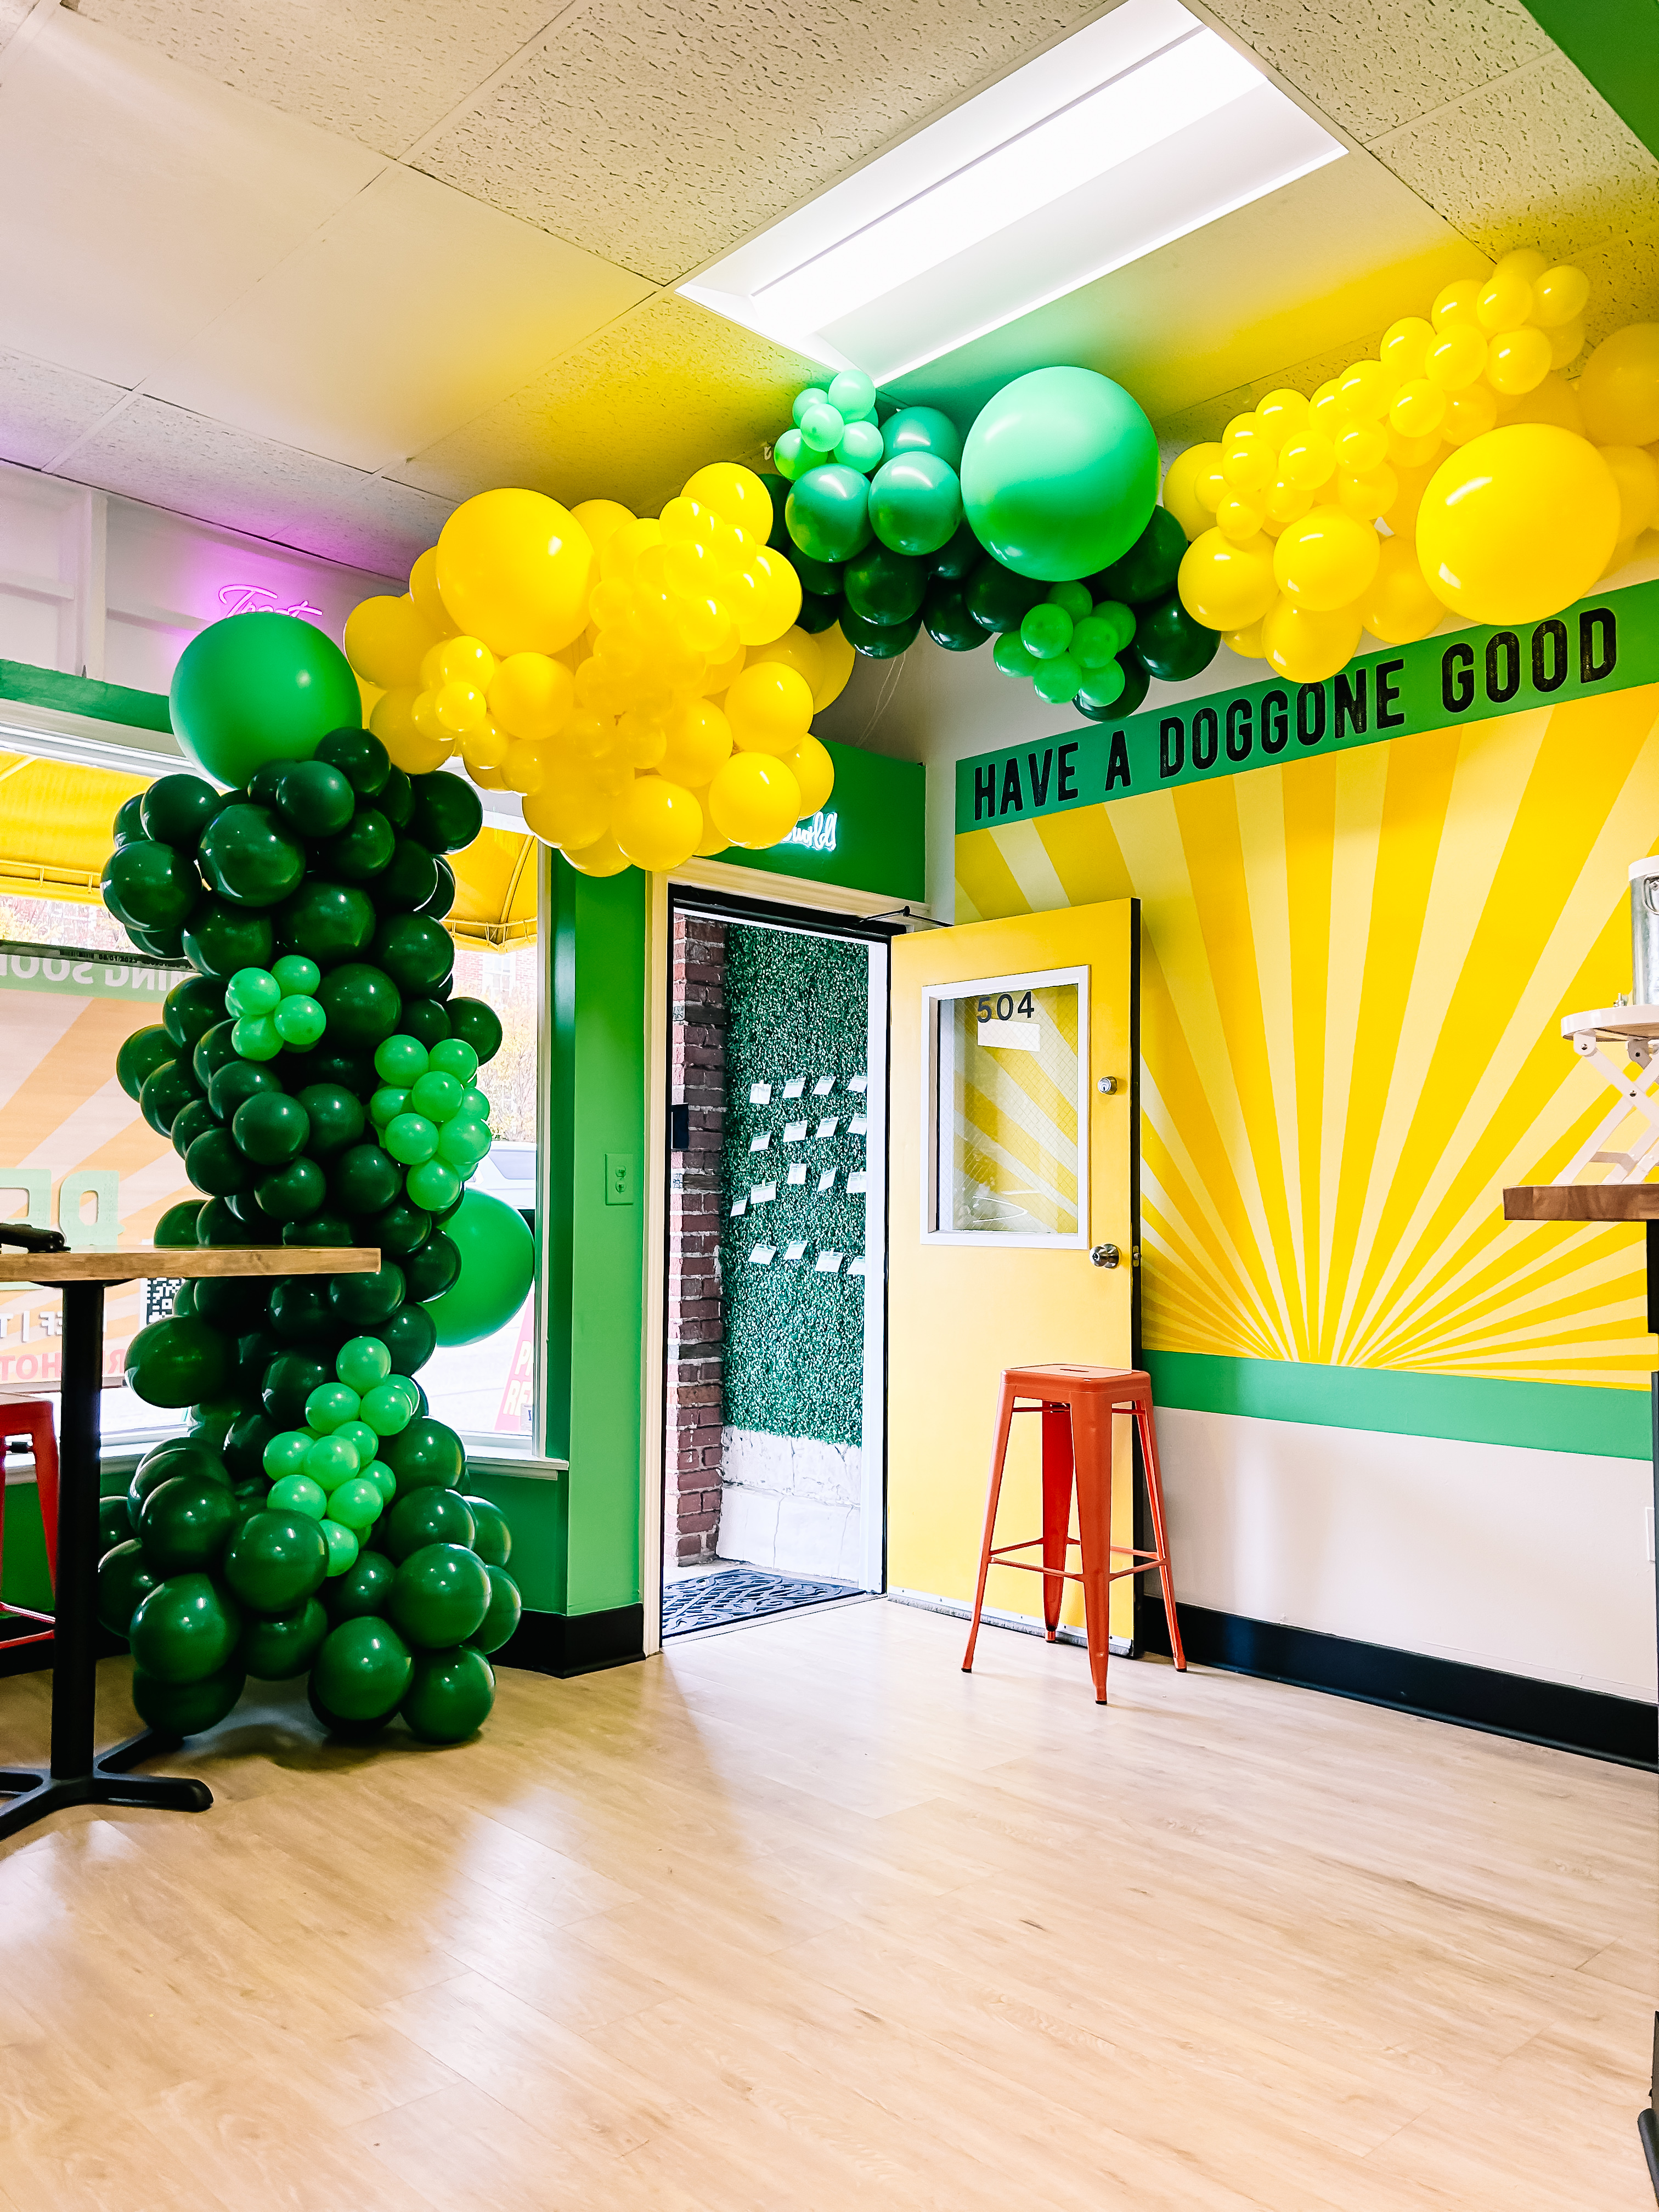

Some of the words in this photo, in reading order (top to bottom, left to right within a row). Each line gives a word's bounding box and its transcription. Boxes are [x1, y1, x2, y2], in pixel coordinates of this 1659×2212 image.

[974, 741, 1079, 821] HAVE
[1104, 729, 1132, 792] A
[1159, 658, 1406, 779] DOGGONE
[1441, 607, 1617, 714] GOOD
[977, 991, 1035, 1023] 504
